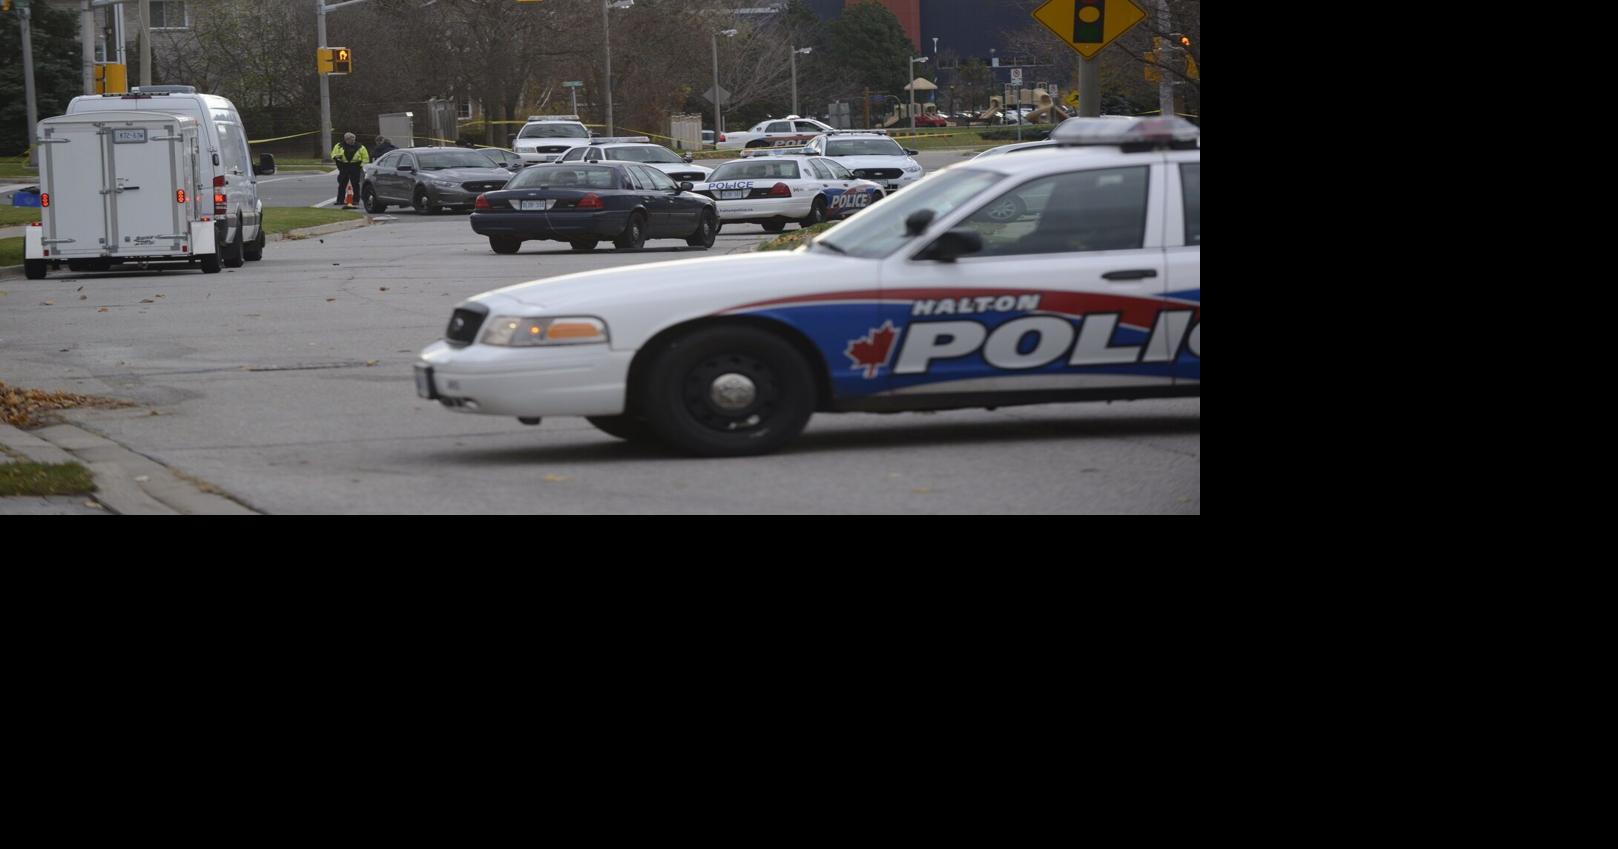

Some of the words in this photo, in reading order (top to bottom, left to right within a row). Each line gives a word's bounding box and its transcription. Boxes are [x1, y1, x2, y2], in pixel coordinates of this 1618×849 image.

[708, 181, 753, 190] POLICE
[831, 193, 868, 208] POLICE
[911, 295, 1041, 315] HALTON
